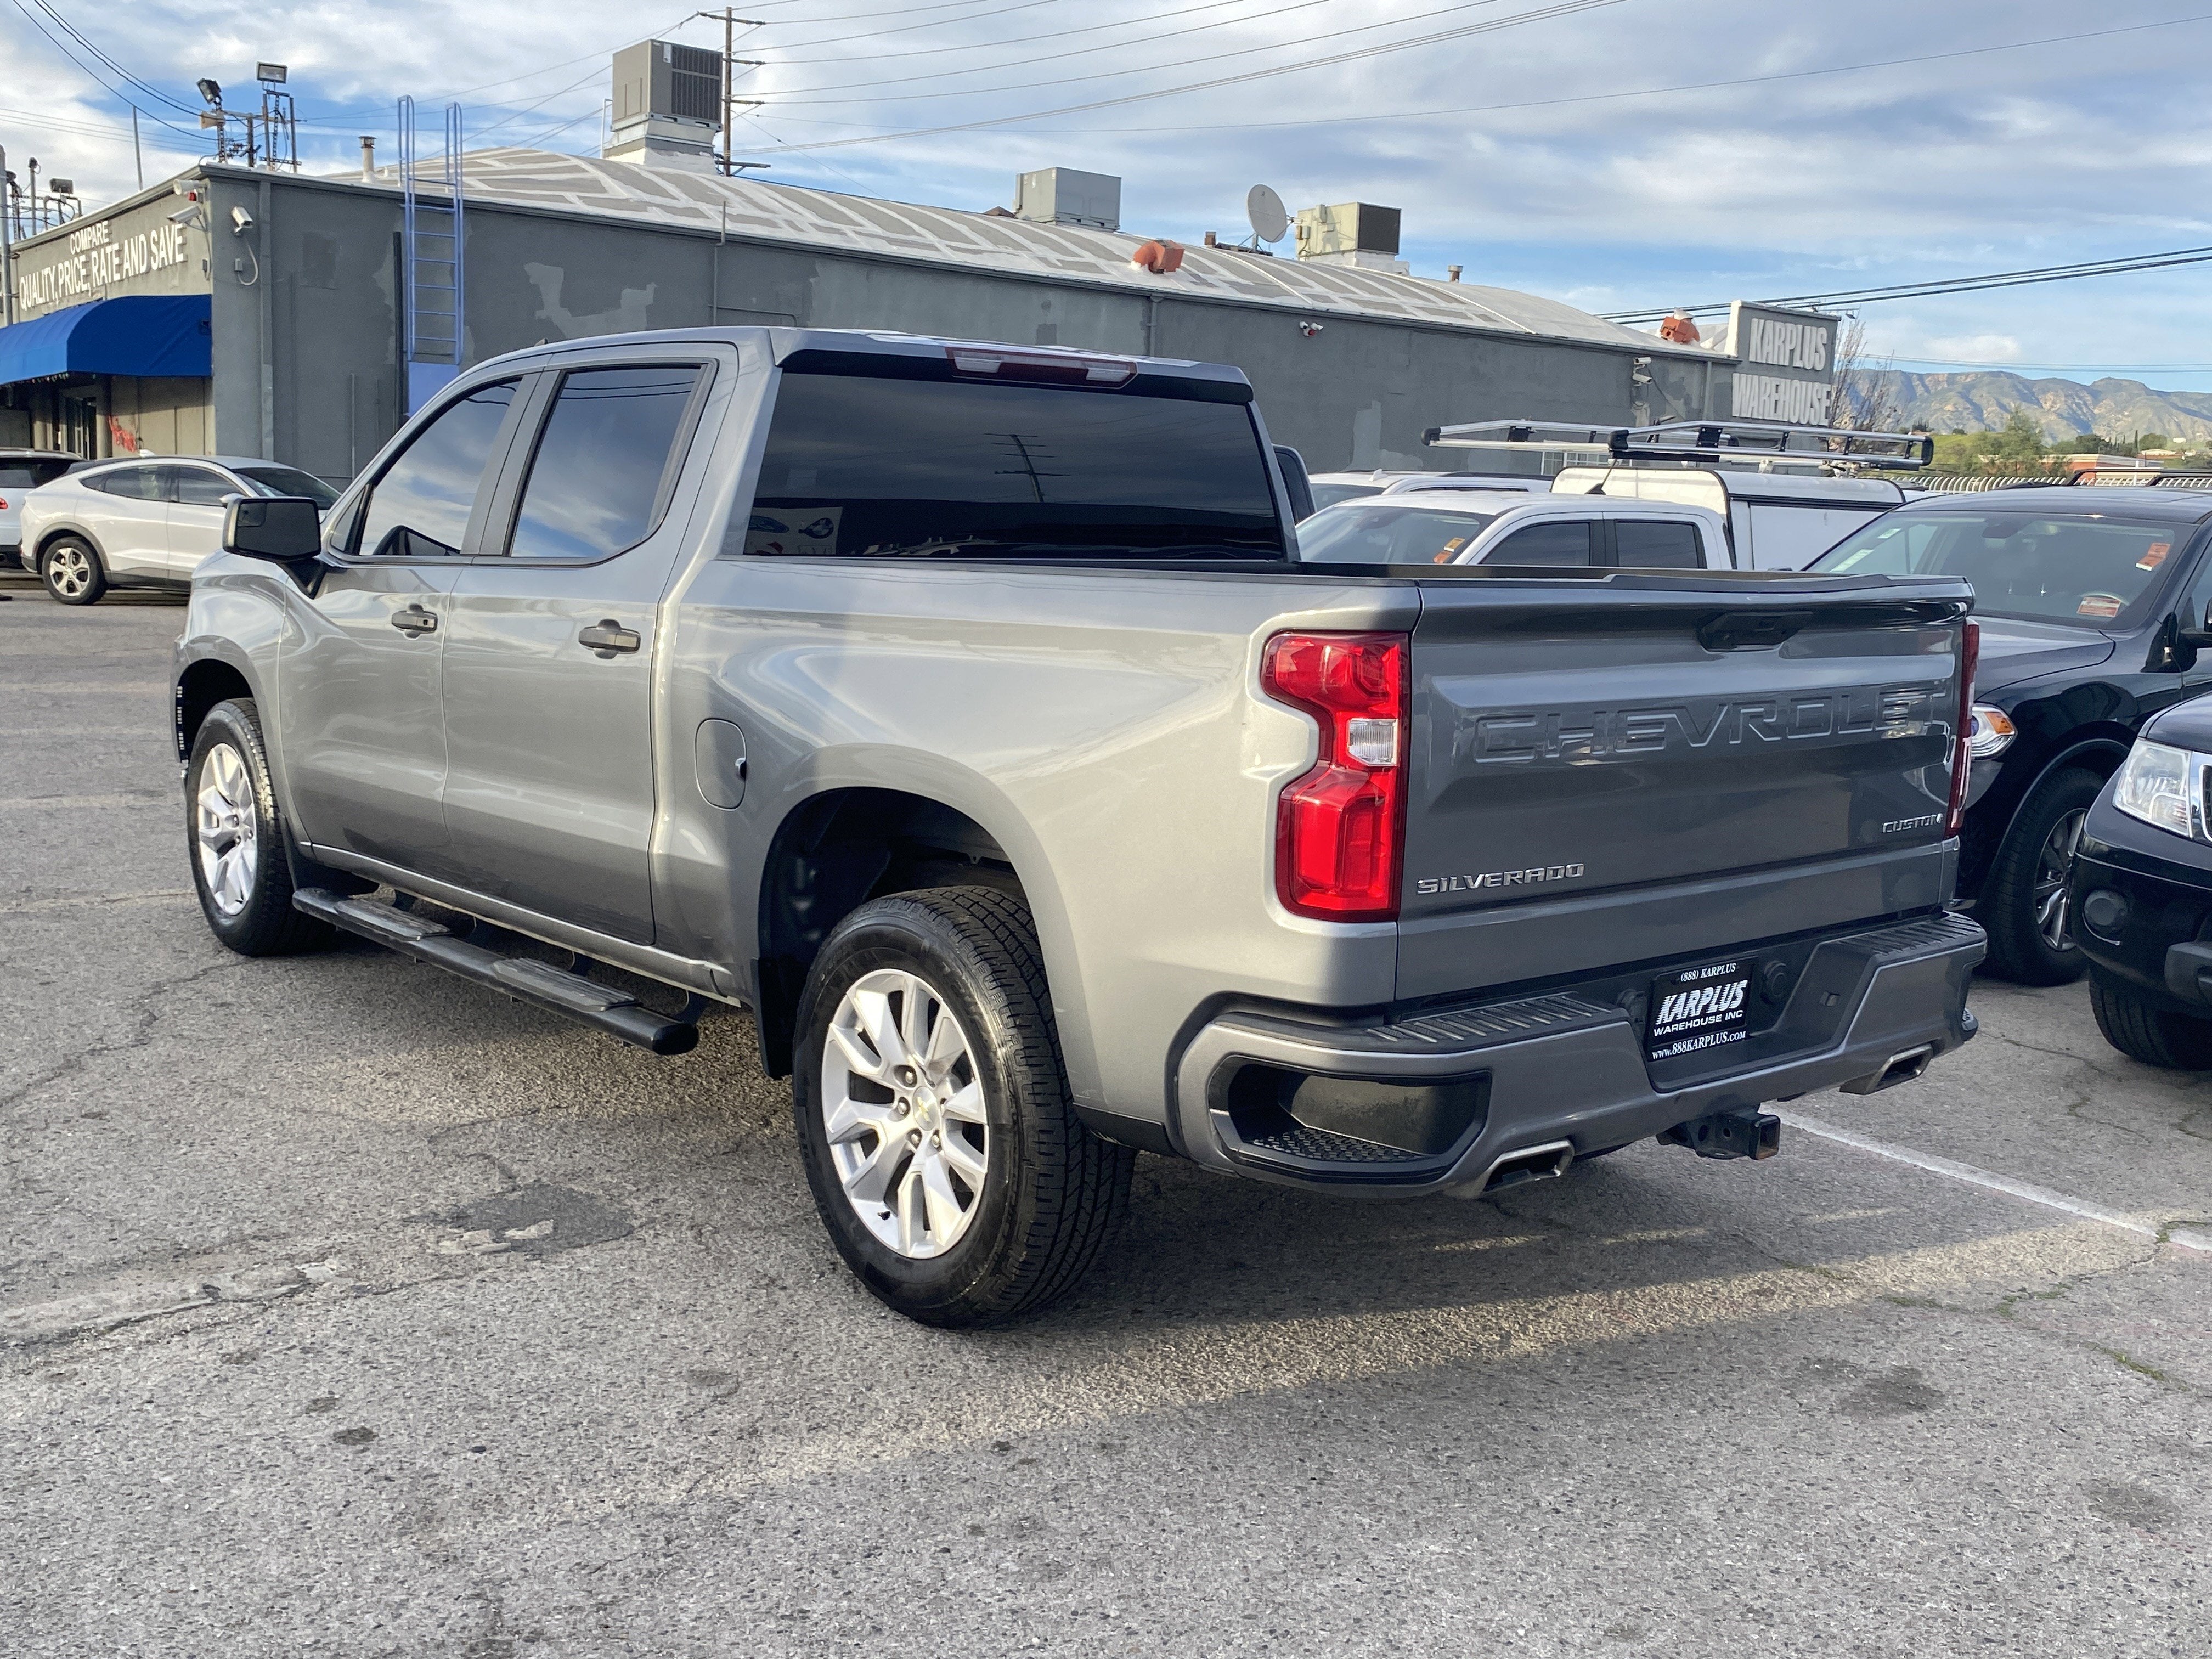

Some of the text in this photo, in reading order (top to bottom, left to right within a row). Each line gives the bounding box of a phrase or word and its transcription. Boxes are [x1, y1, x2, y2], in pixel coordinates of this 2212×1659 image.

[70, 221, 109, 255] COMPARE
[58, 255, 92, 297] PRICE,
[91, 242, 131, 287] RATE
[122, 233, 148, 279] AND
[150, 223, 184, 270] SAVE
[1748, 318, 1827, 371] KARPLUS
[1731, 373, 1831, 426] WAREHOUSE
[1474, 686, 1946, 763] CHEVROLET
[1882, 813, 1944, 833] CUSTOM
[1417, 862, 1584, 895] SILVERADO
[1680, 962, 1736, 982] (888) KARPLUS
[1655, 980, 1748, 1025] KARPLUS
[1654, 1010, 1743, 1036] WAREHOUSE INC
